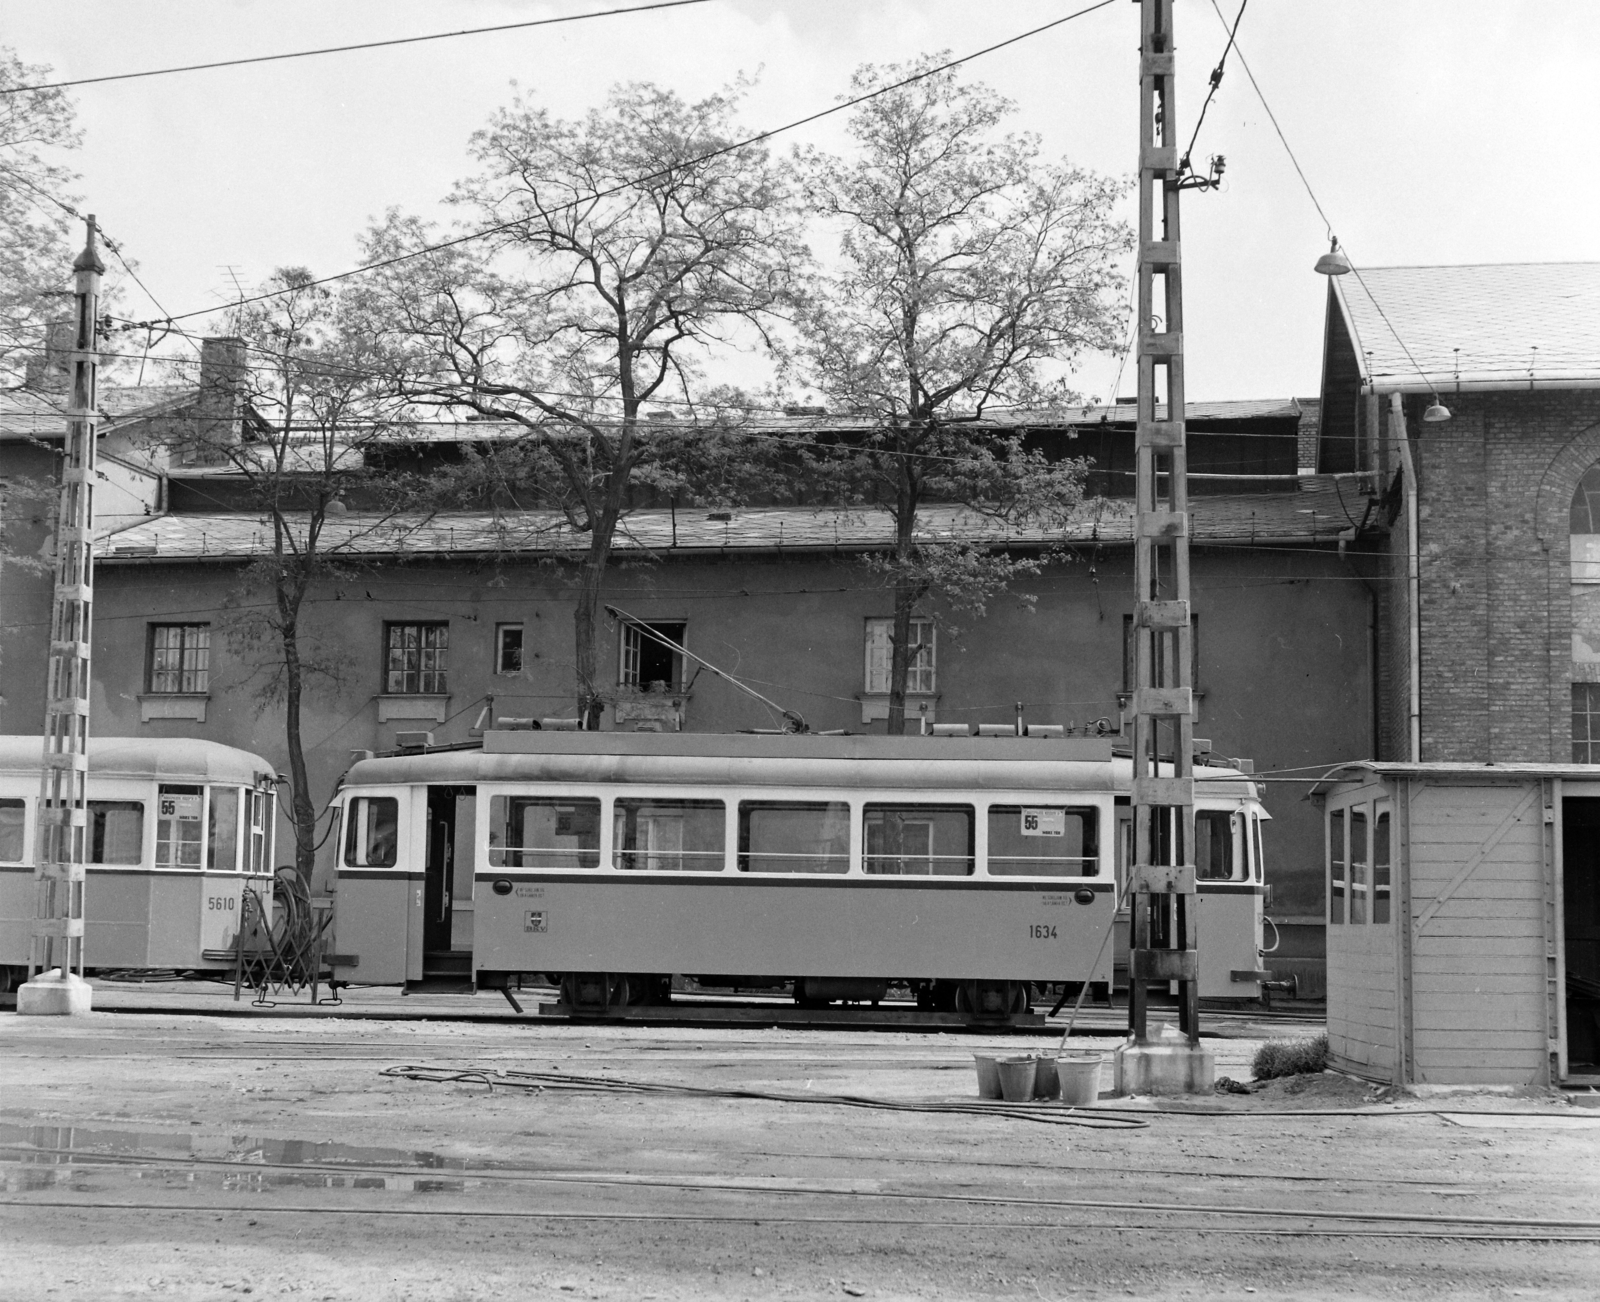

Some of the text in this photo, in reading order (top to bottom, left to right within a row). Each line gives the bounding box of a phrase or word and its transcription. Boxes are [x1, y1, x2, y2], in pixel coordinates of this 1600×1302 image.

[161, 800, 176, 815] 55
[1024, 815, 1039, 830] 55
[208, 897, 235, 910] 5610
[1029, 925, 1058, 939] 1634
